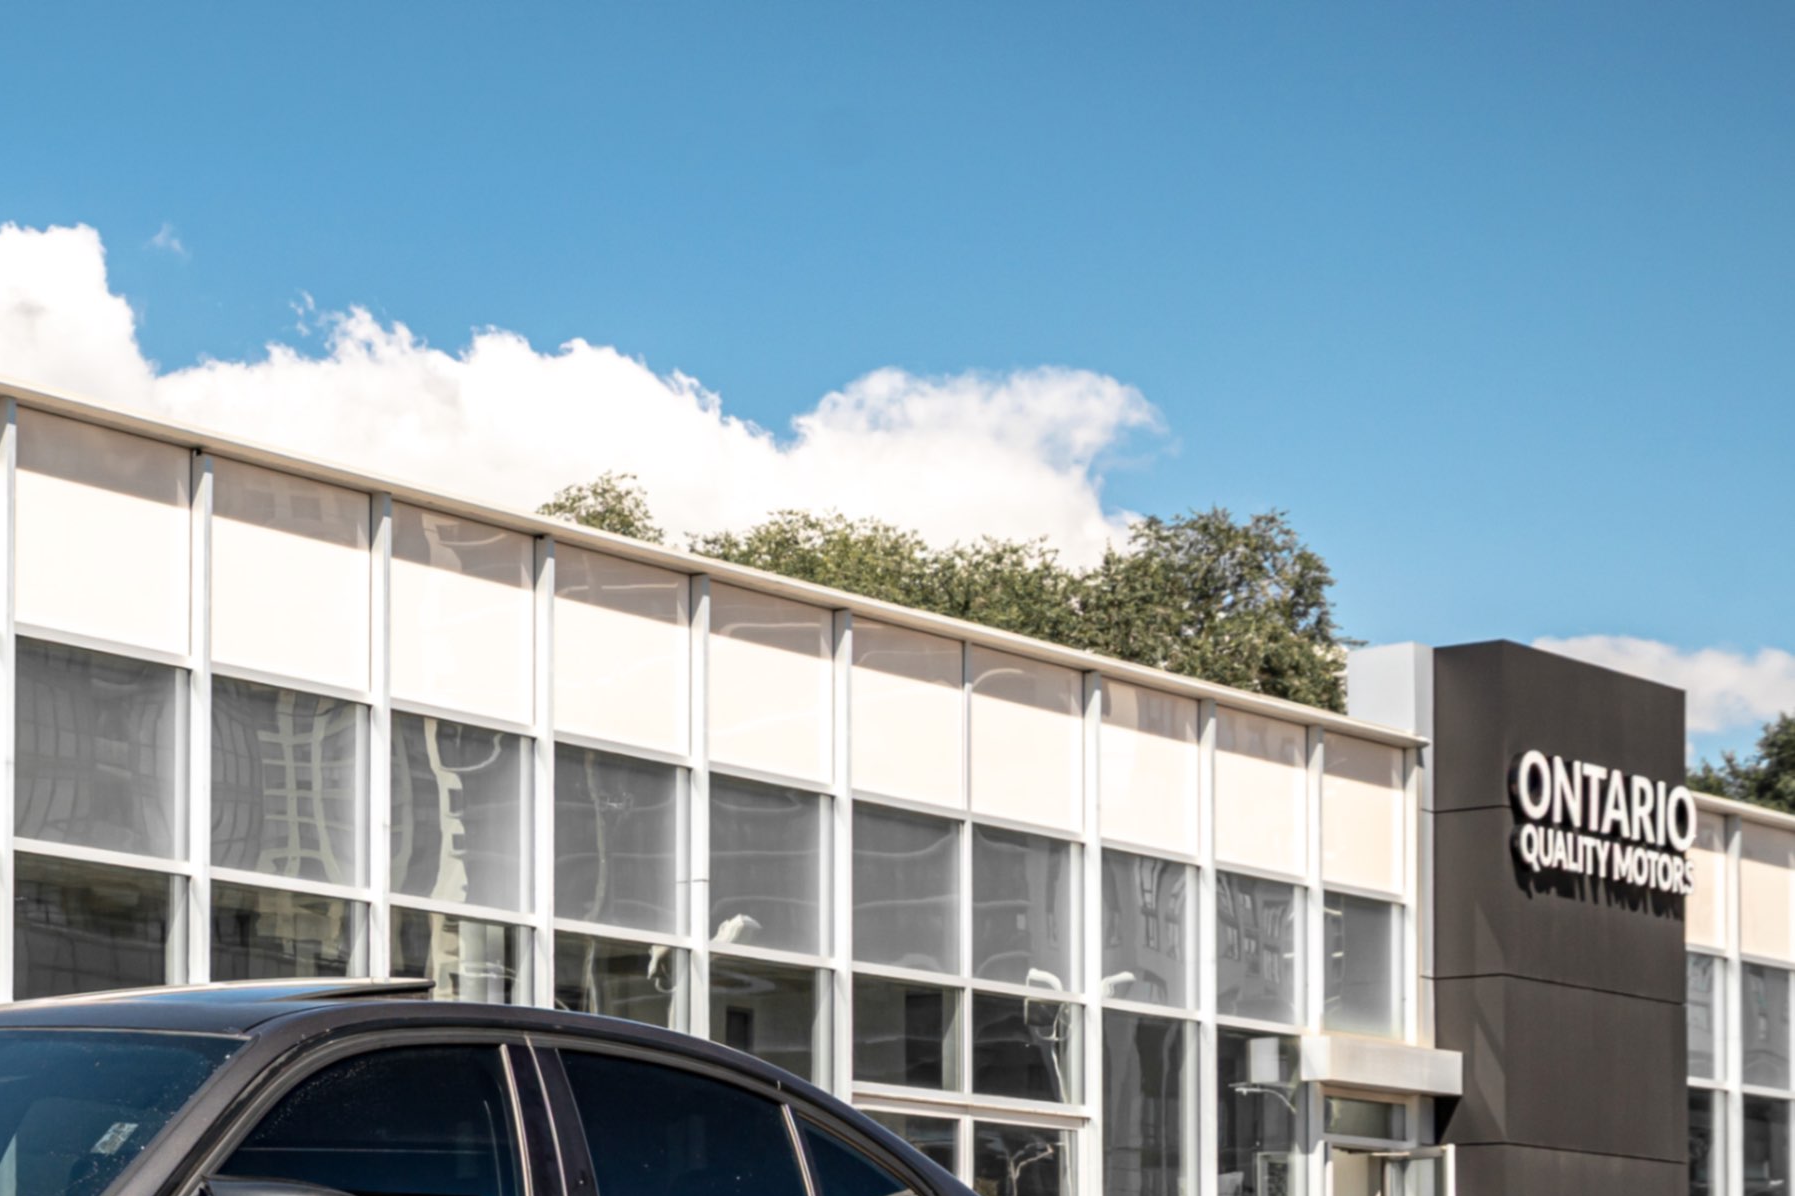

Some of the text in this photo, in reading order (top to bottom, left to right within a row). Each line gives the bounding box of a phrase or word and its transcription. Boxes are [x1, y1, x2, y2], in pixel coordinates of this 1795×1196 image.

[1518, 750, 1697, 851] ONTARIO
[1519, 824, 1695, 895] QUALITY MOTORS
